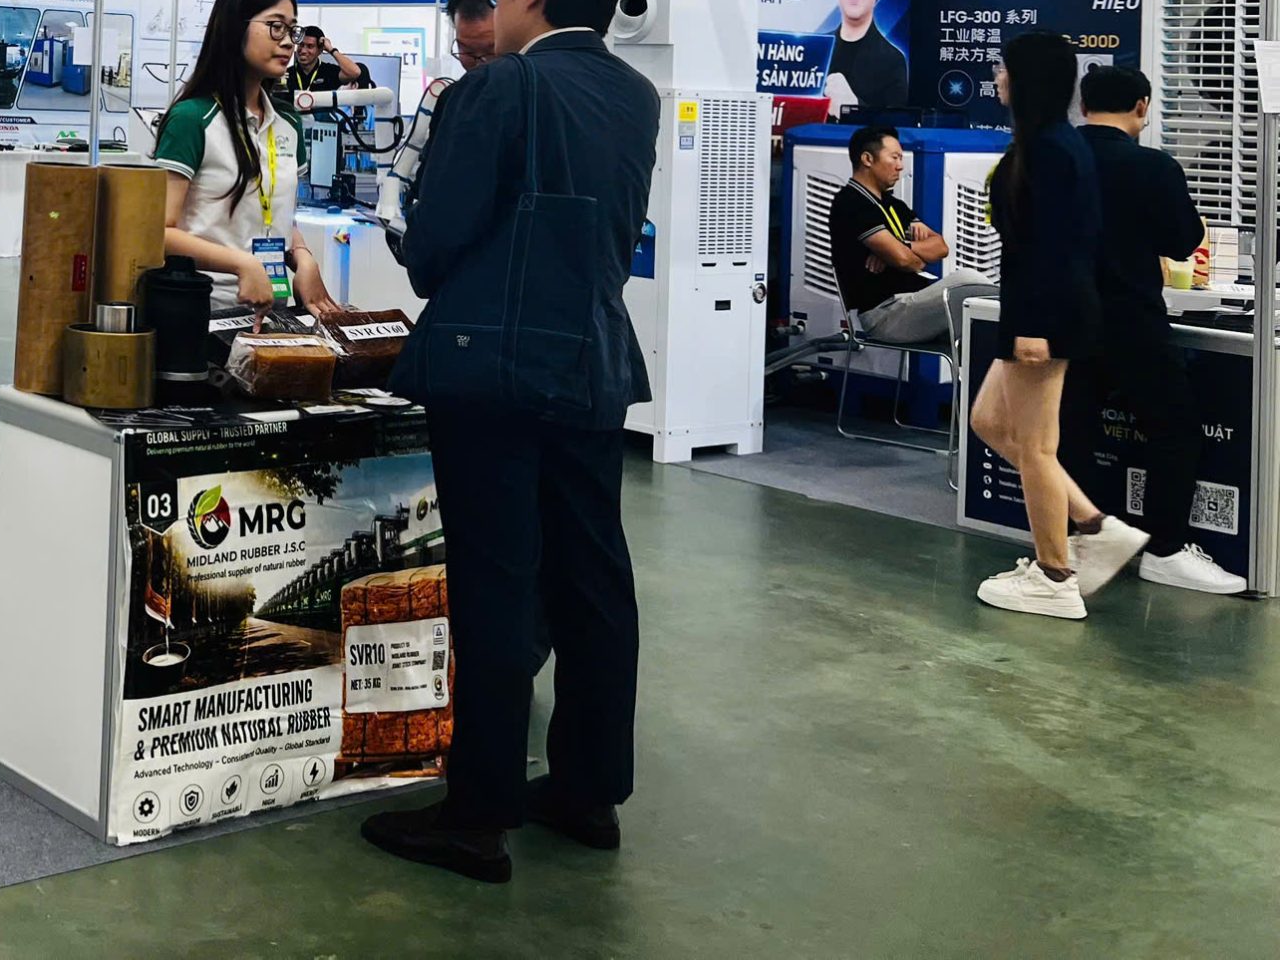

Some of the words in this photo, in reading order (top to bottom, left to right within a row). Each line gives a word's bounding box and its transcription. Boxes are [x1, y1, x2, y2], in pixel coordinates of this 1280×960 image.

[939, 10, 1001, 24] LFG-300
[1004, 8, 1038, 25] 系列
[939, 28, 1002, 44] 工业降温
[769, 41, 805, 62] HÀNG
[761, 63, 788, 87] SẢN
[790, 65, 824, 88] XUẤT
[349, 328, 376, 337] SVR
[377, 325, 404, 336] CV60
[146, 431, 179, 444] GLOBAL
[181, 429, 210, 443] SUPPLY
[220, 425, 254, 439] TRUSTED
[255, 421, 288, 435] PARTNER
[1103, 424, 1131, 441] VIỆT
[147, 493, 171, 518] 03
[238, 499, 306, 538] MRG
[186, 549, 237, 568] MIDLAND
[240, 543, 280, 561] RUBBER
[282, 540, 306, 555] J.S.C
[186, 568, 227, 584] Professional
[227, 565, 255, 580] supplier
[254, 563, 262, 573] of
[262, 560, 285, 571] natural
[285, 558, 306, 569] rubber
[349, 642, 386, 666] SVR10
[350, 678, 363, 691] NET:
[364, 677, 372, 690] 35
[372, 676, 382, 689] KG
[138, 699, 190, 732] SMART
[194, 678, 313, 719] MANUFACTURING
[133, 740, 146, 761] &
[150, 724, 218, 758] PREMIUM
[221, 716, 284, 748] NATURAL
[286, 706, 331, 736] RUBBER
[133, 765, 172, 779] Advanced
[173, 759, 214, 776] Technology
[221, 751, 255, 765] Consistent
[255, 744, 277, 758] Quality
[284, 739, 305, 752] Global
[305, 735, 331, 748] Standard
[262, 798, 276, 806] HIGH
[133, 828, 160, 838] MODERN
